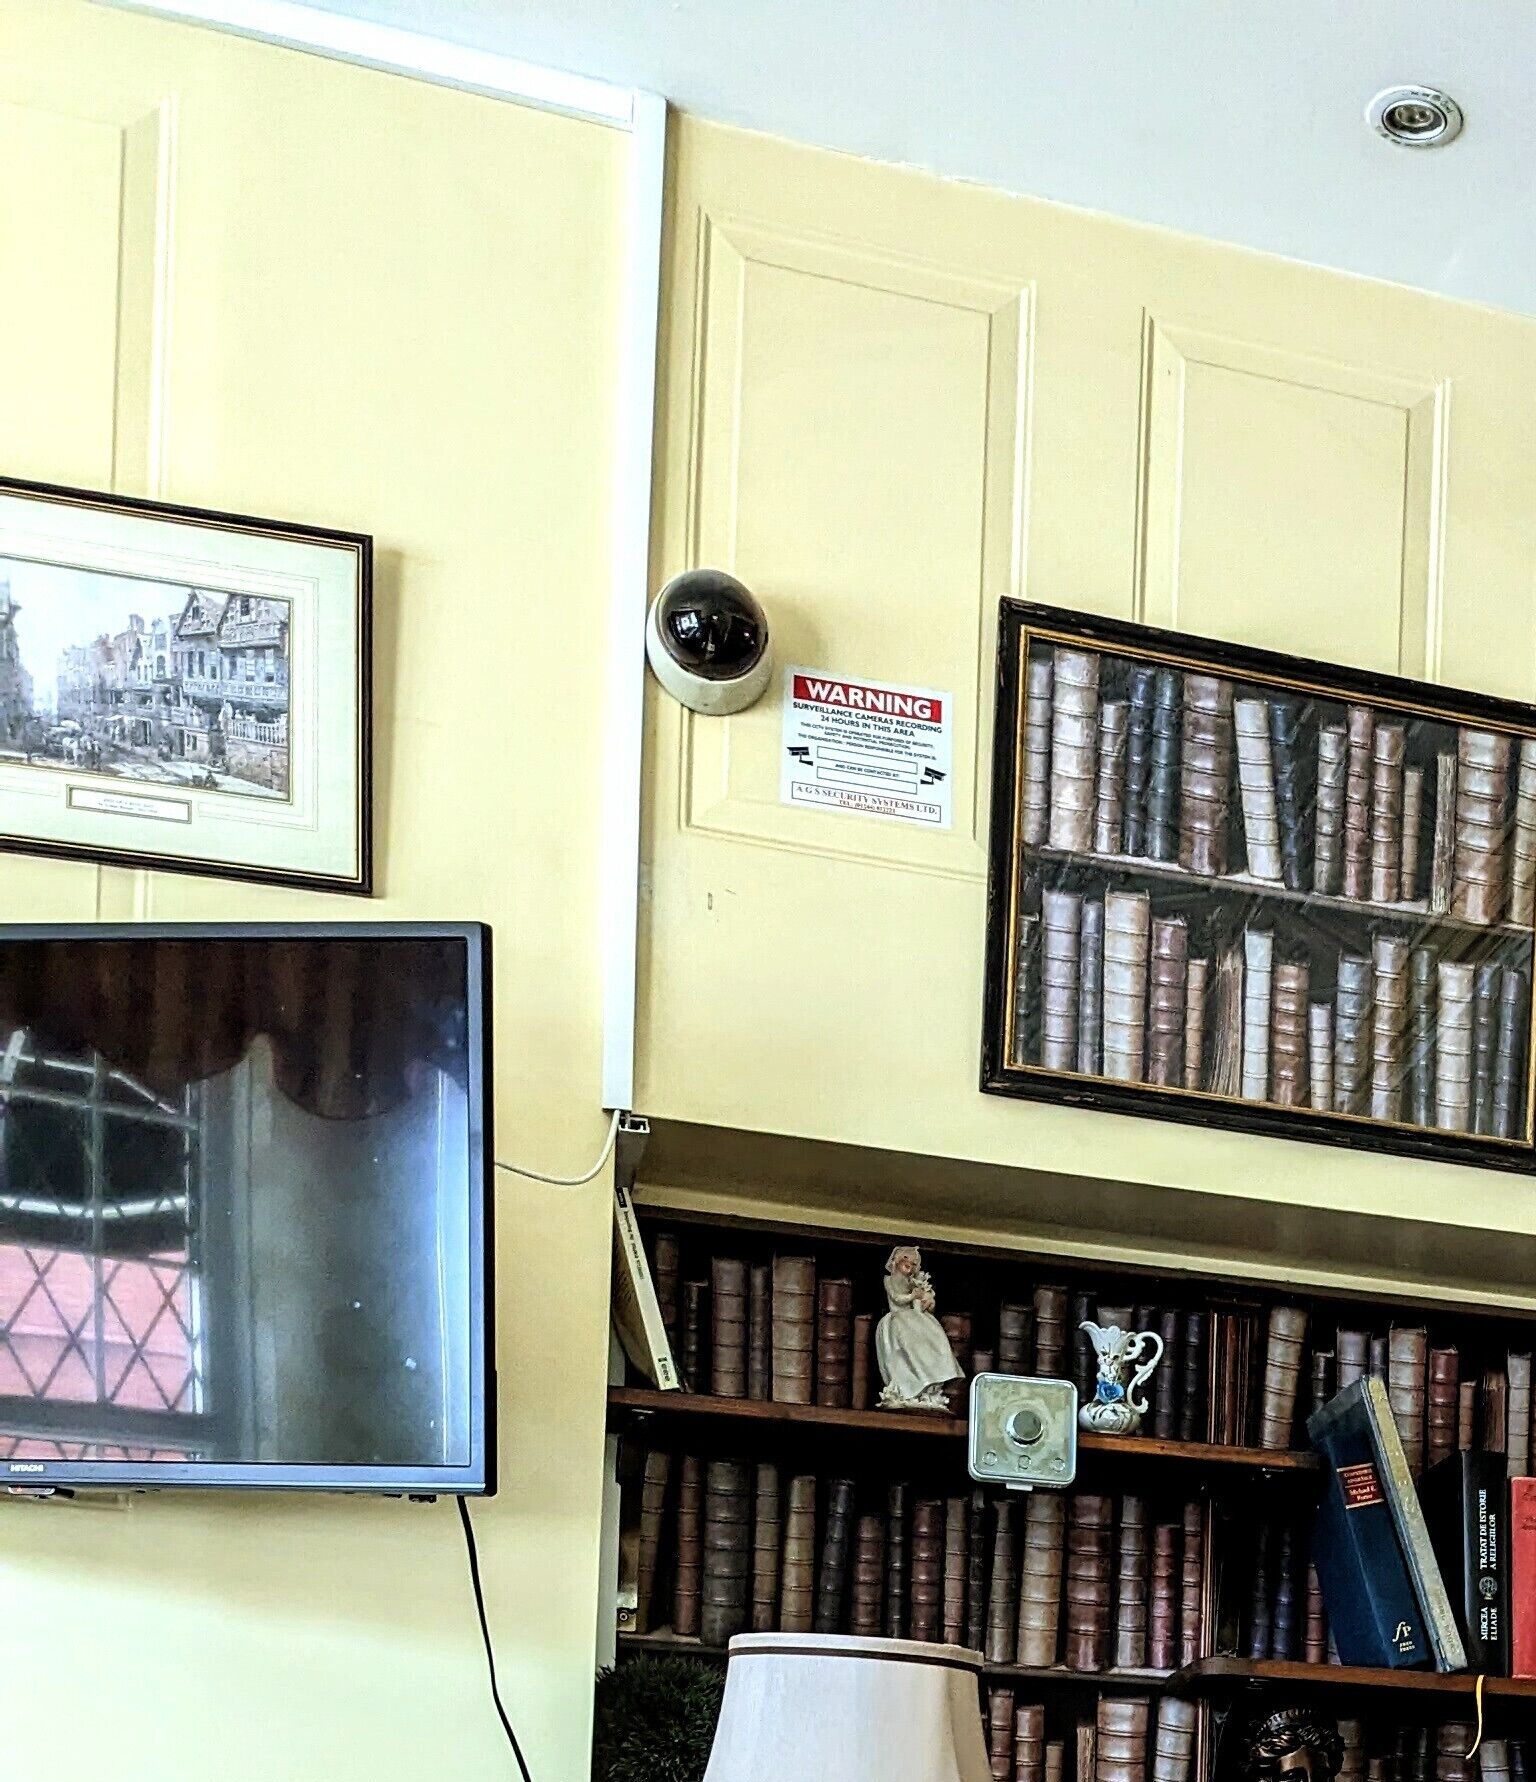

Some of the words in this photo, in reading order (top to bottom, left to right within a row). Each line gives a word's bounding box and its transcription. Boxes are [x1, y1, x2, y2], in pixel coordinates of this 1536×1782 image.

[806, 680, 931, 718] WARNING
[793, 702, 852, 718] SURVEILLANCE
[855, 713, 893, 725] CAMERAS
[896, 720, 942, 734] RECORDING
[832, 717, 859, 727] HOURS
[873, 724, 891, 733] THIS
[893, 728, 915, 737] AREA
[823, 789, 868, 802] SECURITY
[872, 795, 914, 811] SYSTEMS
[1478, 1489, 1487, 1521] ISTORIE
[1479, 1521, 1488, 1536] DE
[1479, 1537, 1489, 1570] TRATAT
[1480, 1607, 1489, 1641] MIRCEA
[1490, 1607, 1498, 1641] ELIADE
